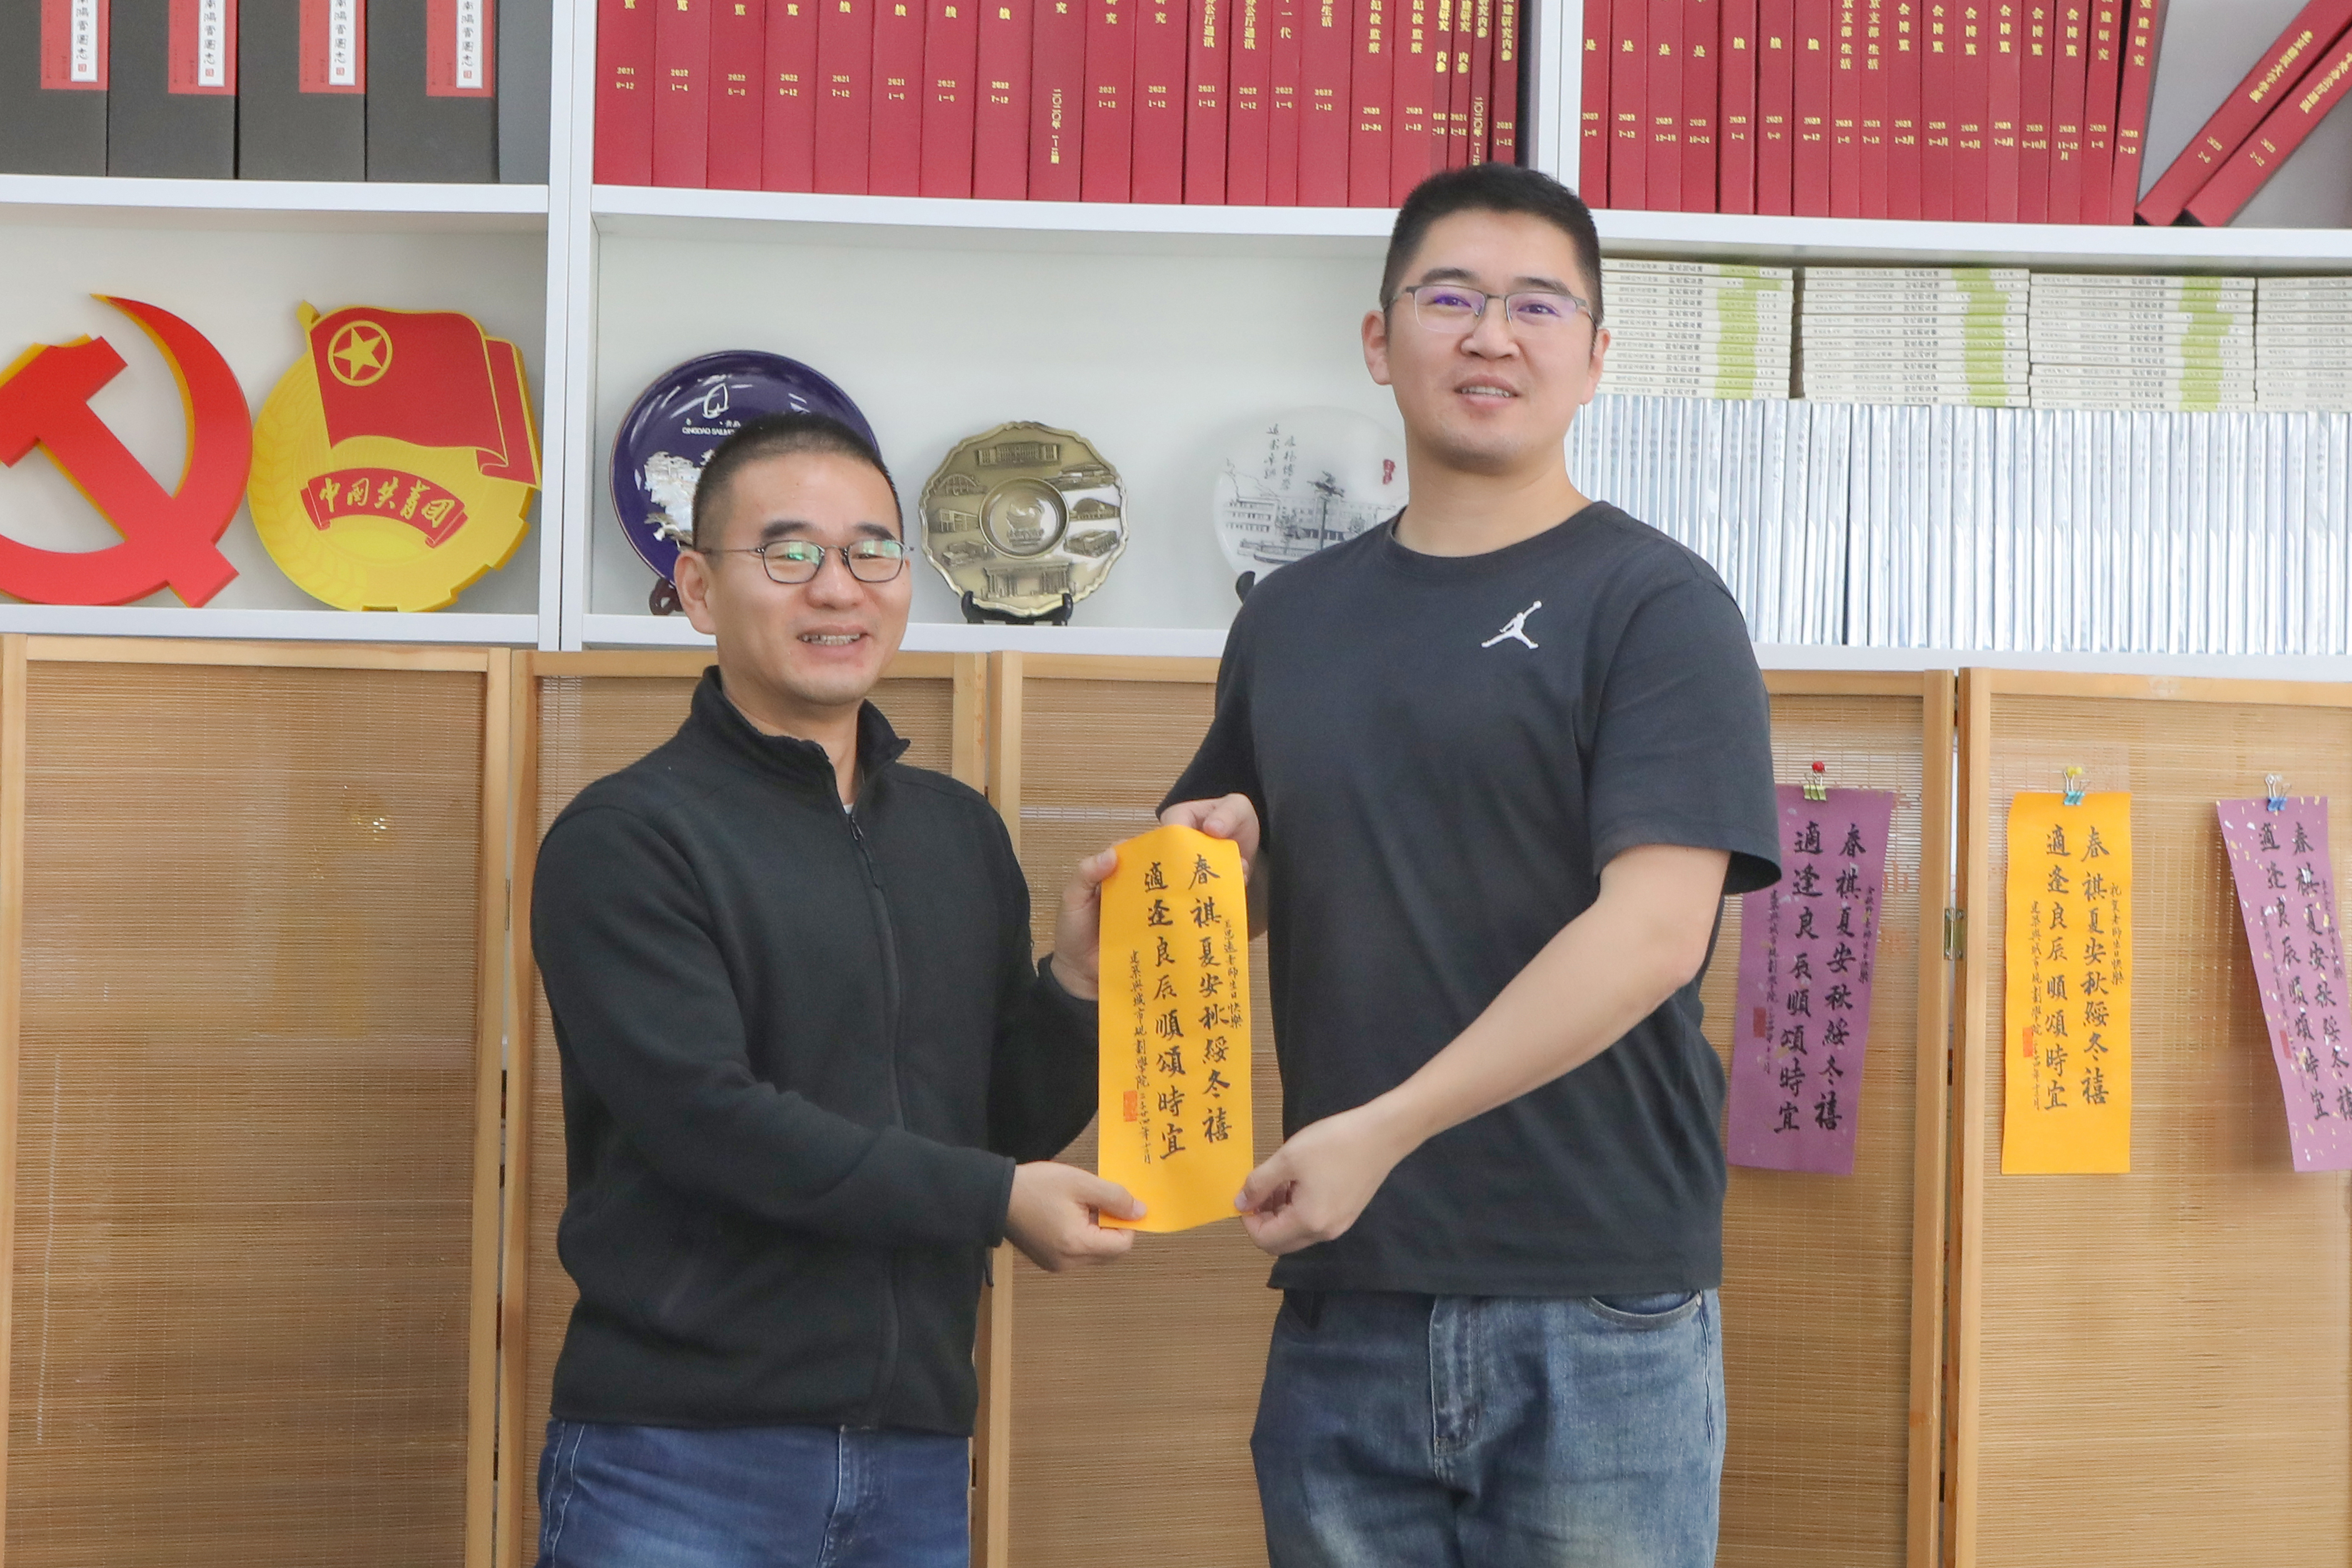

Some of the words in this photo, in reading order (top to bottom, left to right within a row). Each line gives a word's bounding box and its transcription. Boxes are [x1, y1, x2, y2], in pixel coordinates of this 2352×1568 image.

[1501, 0, 1514, 61] 建研究内参
[2098, 0, 2113, 61] 建研究
[670, 69, 689, 77] 2022
[780, 73, 798, 82] 2022
[833, 74, 849, 82] 2021
[938, 79, 956, 88] 2022
[991, 81, 1009, 89] 2022
[1148, 85, 1166, 93] 2022
[1239, 87, 1257, 95] 2022
[1148, 100, 1166, 108] 1-12
[1315, 103, 1333, 111] 1-12
[1433, 112, 1446, 121] 022
[319, 477, 456, 528] 中国共青团
[2044, 824, 2072, 1111] 適逢良辰順頌時宜
[2080, 826, 2110, 1105] 春祺夏安秋綏冬禧
[1773, 821, 1825, 1134] 適逢良辰順頌時宜
[1813, 822, 1868, 1132] 春祺夏安秋綏冬禧
[1186, 853, 1234, 1145] 春祺夏安秋綏冬禧
[1145, 862, 1188, 1161] 適逢良辰順頌時宜
